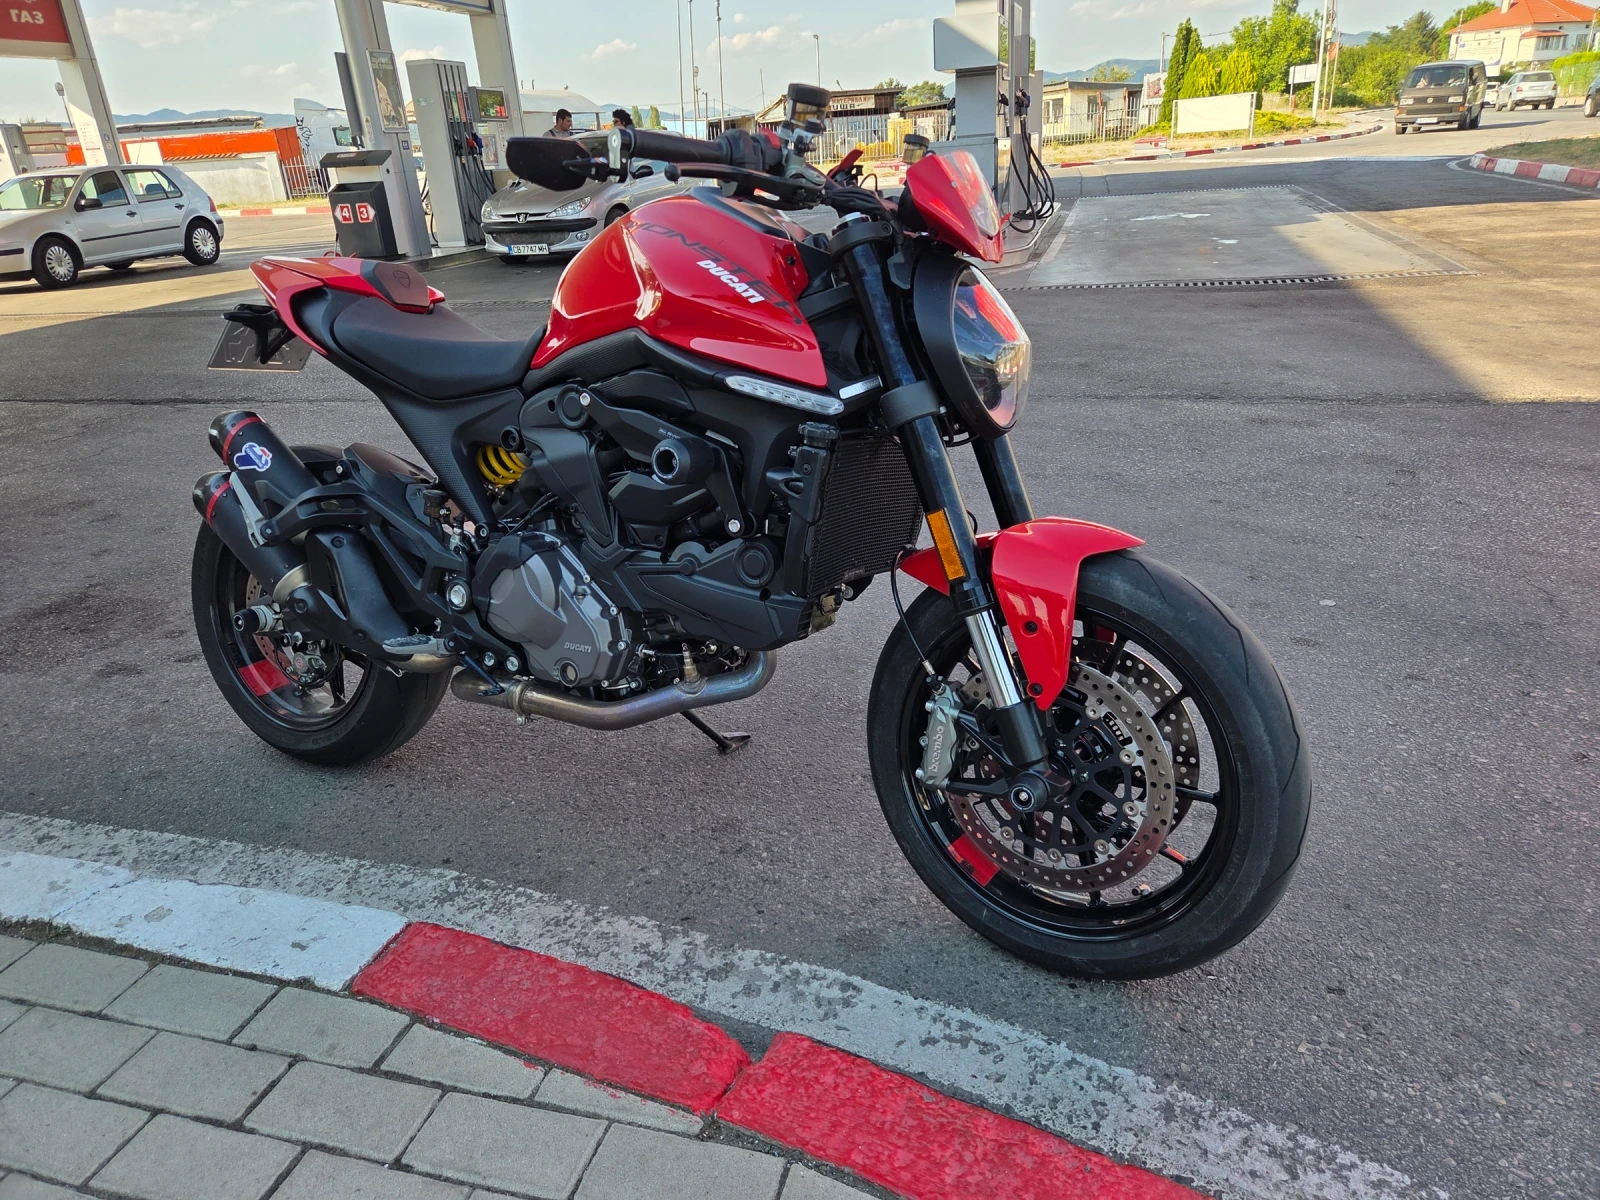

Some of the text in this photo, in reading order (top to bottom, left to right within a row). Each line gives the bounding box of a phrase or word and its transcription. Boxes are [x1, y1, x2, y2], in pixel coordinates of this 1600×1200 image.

[10, 9, 45, 24] ГАЗ
[342, 207, 350, 218] 4
[360, 207, 368, 219] 3
[696, 259, 766, 304] DUCATI
[564, 641, 592, 653] DUCATI
[928, 725, 945, 773] brembo
